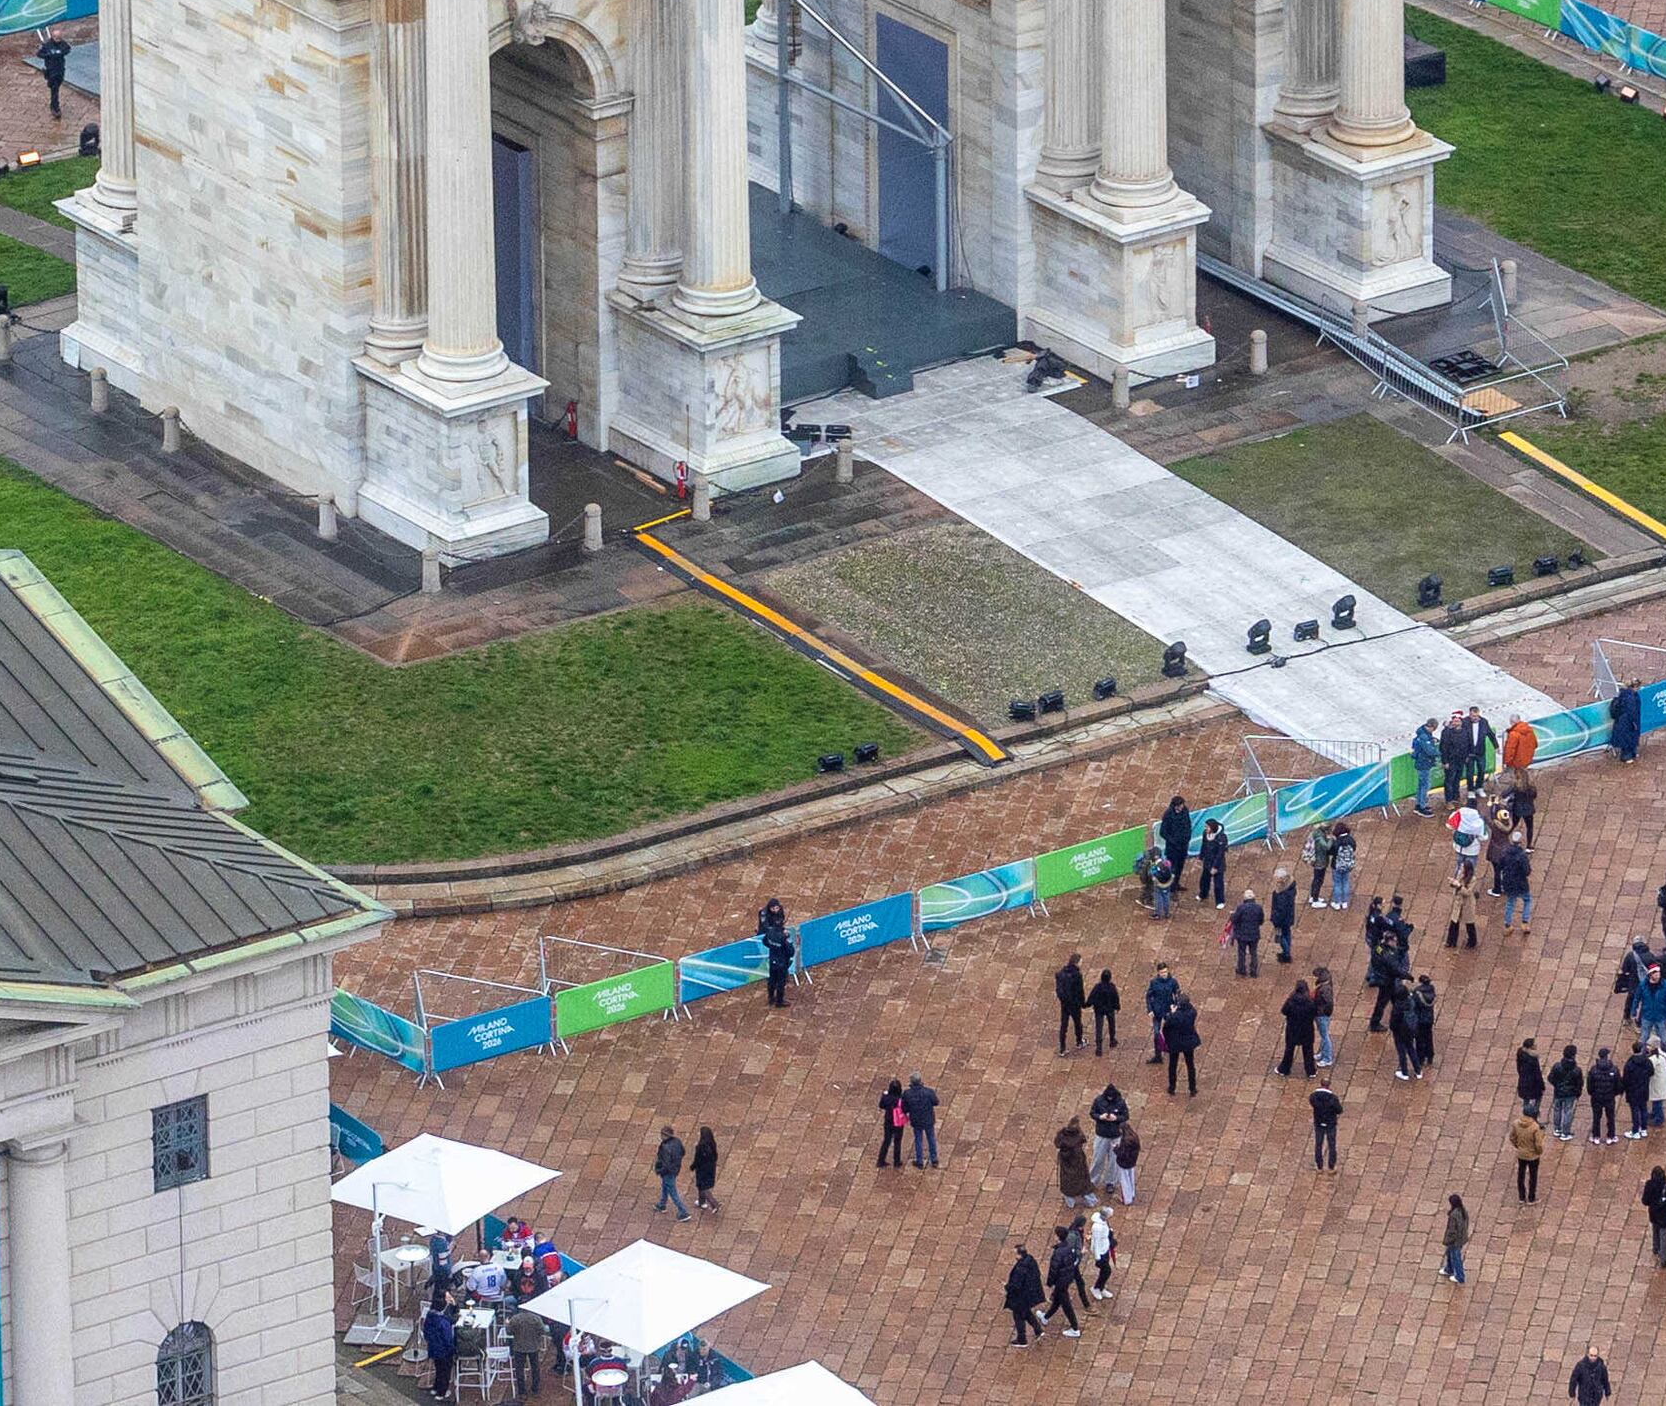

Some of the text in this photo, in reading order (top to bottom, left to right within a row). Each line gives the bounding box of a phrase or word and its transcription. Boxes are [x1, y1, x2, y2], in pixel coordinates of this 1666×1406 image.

[1069, 846, 1107, 865] MILANO
[1075, 854, 1114, 871] CORTINA
[833, 913, 872, 932] MILANO
[839, 920, 880, 938] CORTINA
[847, 934, 867, 946] 2026
[592, 982, 632, 1001] MILANO
[598, 990, 640, 1008] CORTINA
[606, 1003, 627, 1015] 2026
[468, 1017, 508, 1036] MILANO
[474, 1024, 516, 1043] CORTINA
[482, 1038, 503, 1051] 2026
[487, 1275, 497, 1287] 18
